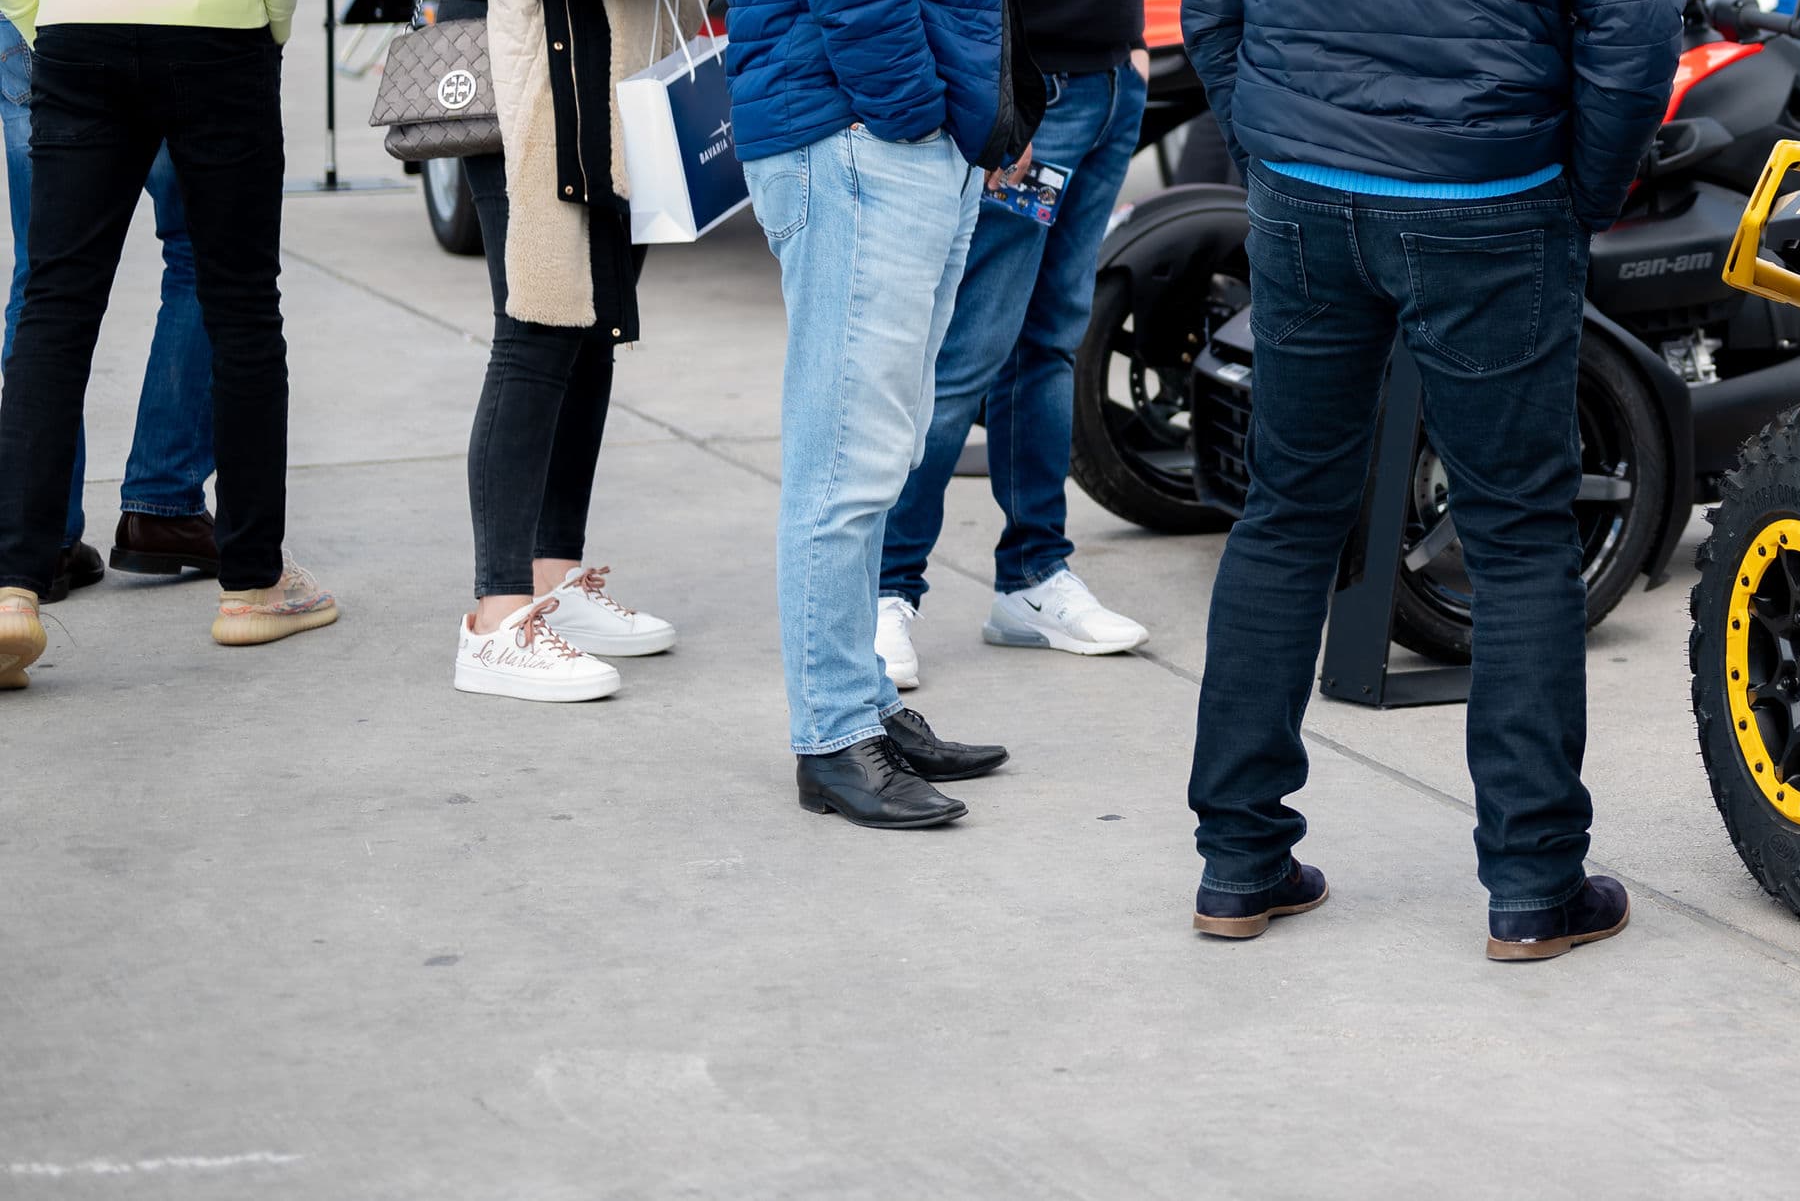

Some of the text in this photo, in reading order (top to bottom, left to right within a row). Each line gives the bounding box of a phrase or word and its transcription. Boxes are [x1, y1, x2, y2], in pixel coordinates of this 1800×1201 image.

[699, 138, 728, 165] BAVARIA
[1619, 252, 1713, 279] can-am
[472, 639, 555, 670] La Martina
